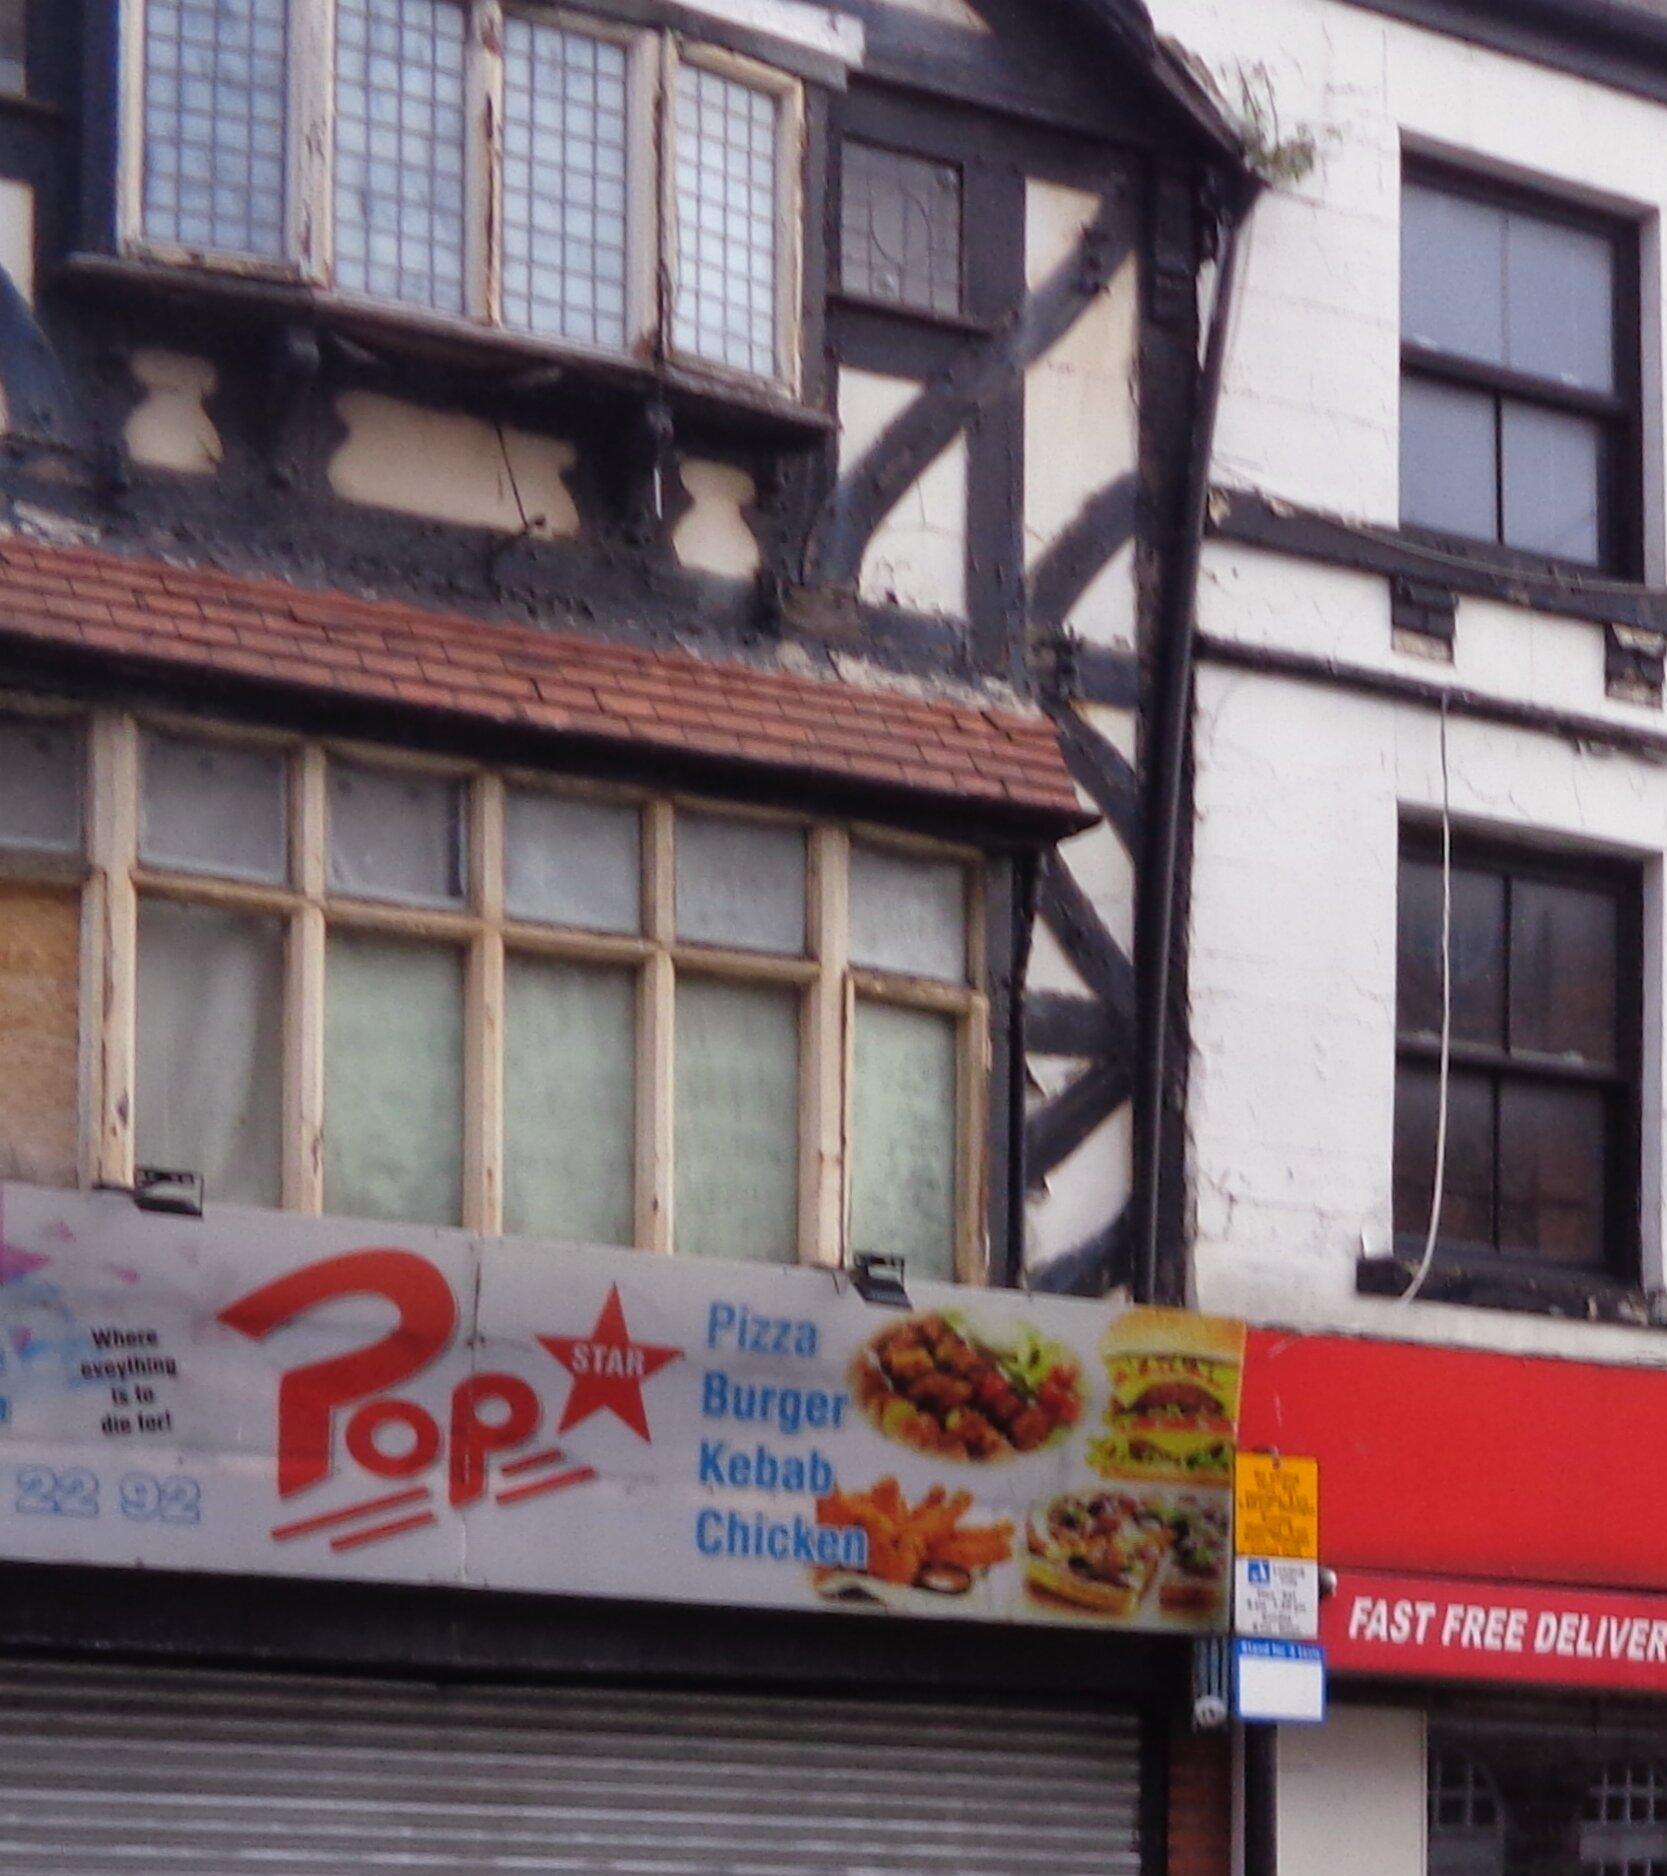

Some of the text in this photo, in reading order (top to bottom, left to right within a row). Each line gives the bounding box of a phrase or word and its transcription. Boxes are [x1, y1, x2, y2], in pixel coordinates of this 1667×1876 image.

[92, 1326, 159, 1349] Where
[706, 1301, 818, 1357] Pizza
[569, 1342, 646, 1379] STAR
[111, 1384, 155, 1406] is to
[701, 1370, 851, 1434] Burger
[101, 1411, 173, 1436] die for!
[15, 1463, 201, 1525] 22 92
[698, 1438, 834, 1496] Kebab
[694, 1507, 869, 1568] Chicken
[1348, 1596, 1437, 1645] FAST
[1441, 1603, 1529, 1653] FREE
